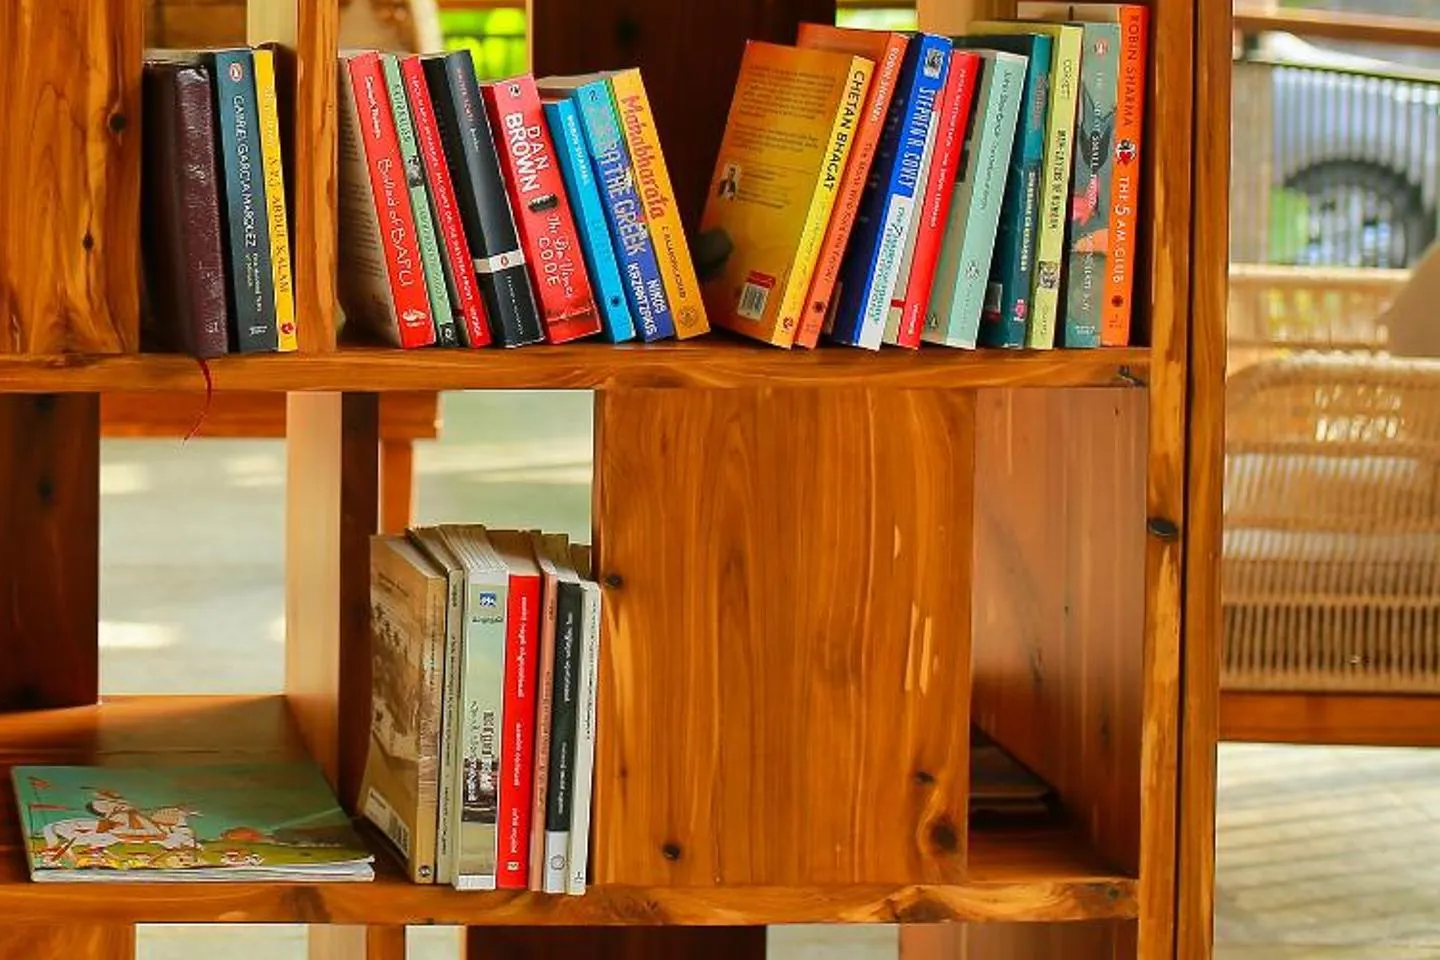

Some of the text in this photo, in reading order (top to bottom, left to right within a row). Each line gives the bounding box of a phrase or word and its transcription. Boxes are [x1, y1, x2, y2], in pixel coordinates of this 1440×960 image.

[1122, 14, 1139, 126] ROBIN SHARMA
[821, 69, 866, 192] CHETAN BHAGAT
[908, 84, 937, 138] STEPHEN
[502, 110, 541, 193] BROWN
[524, 123, 550, 172] DAN
[622, 95, 668, 221] Mahabharata
[896, 150, 920, 189] COVEY
[602, 161, 632, 202] THE
[612, 196, 647, 260] GREEK
[889, 223, 903, 236] 7
[1111, 175, 1130, 284] THE 5 AM CLUB
[275, 244, 289, 293] KALAM
[535, 234, 561, 288] CODE
[625, 260, 657, 337] KAZANTZAKIS
[646, 276, 667, 315] NIKOS
